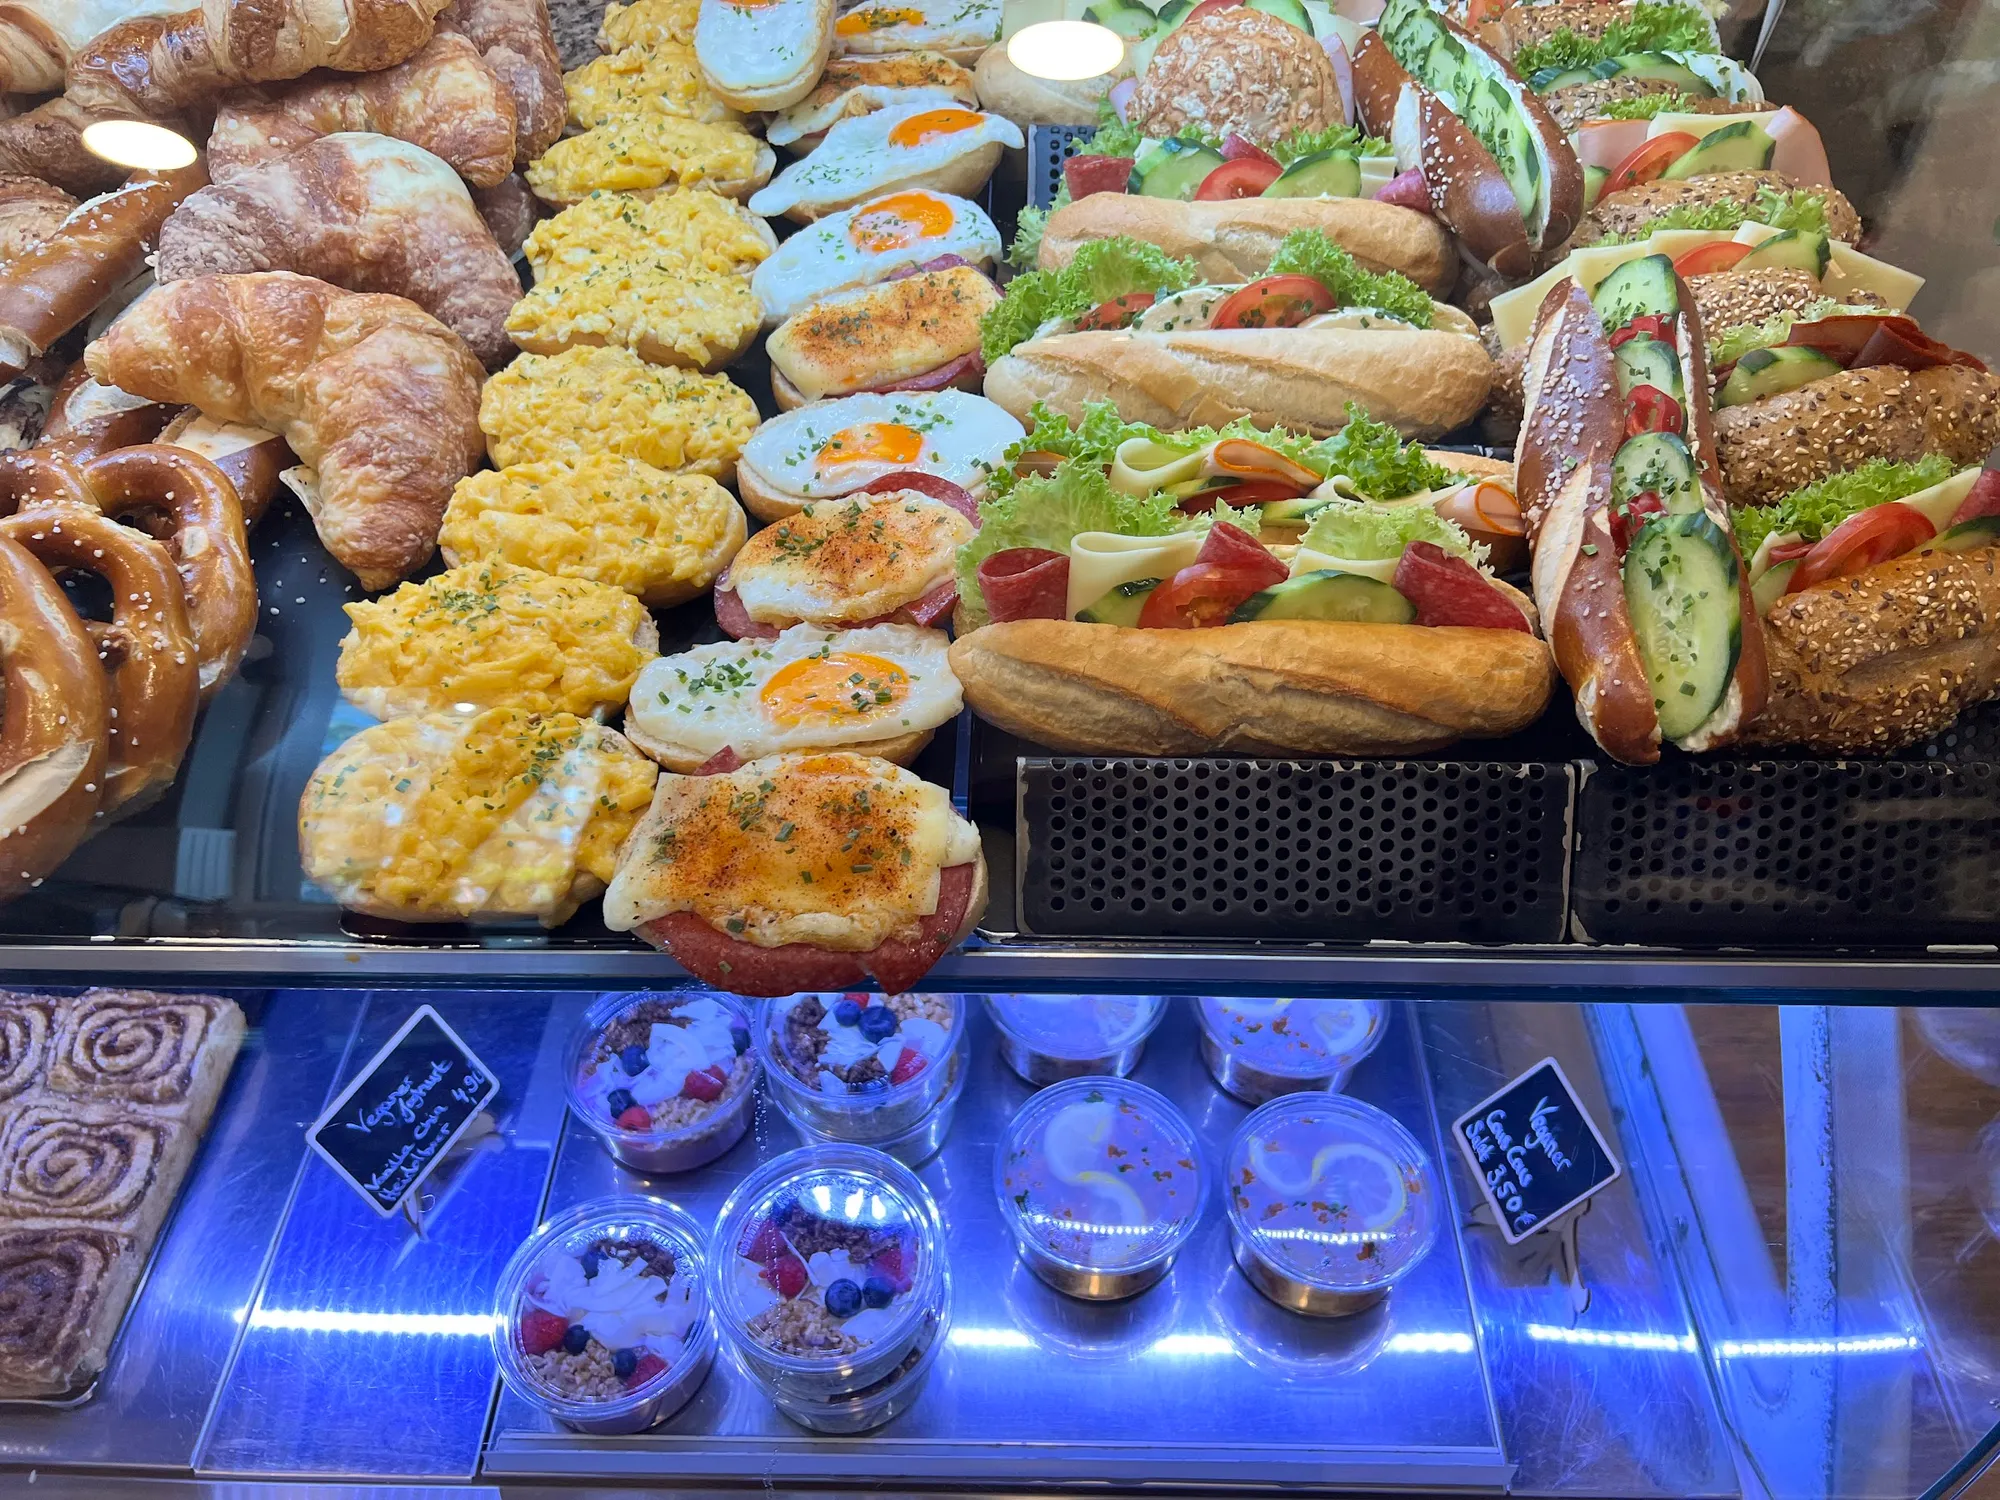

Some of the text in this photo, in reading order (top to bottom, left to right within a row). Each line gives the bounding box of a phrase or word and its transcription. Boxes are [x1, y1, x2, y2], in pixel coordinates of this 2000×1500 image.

[346, 1074, 414, 1134] Veganer
[398, 1059, 455, 1124] Joghurt
[413, 1105, 450, 1141] Chia
[1465, 1119, 1496, 1164] Salat
[1486, 1109, 1534, 1188] Cous Cous
[1524, 1095, 1573, 1173] Veganer
